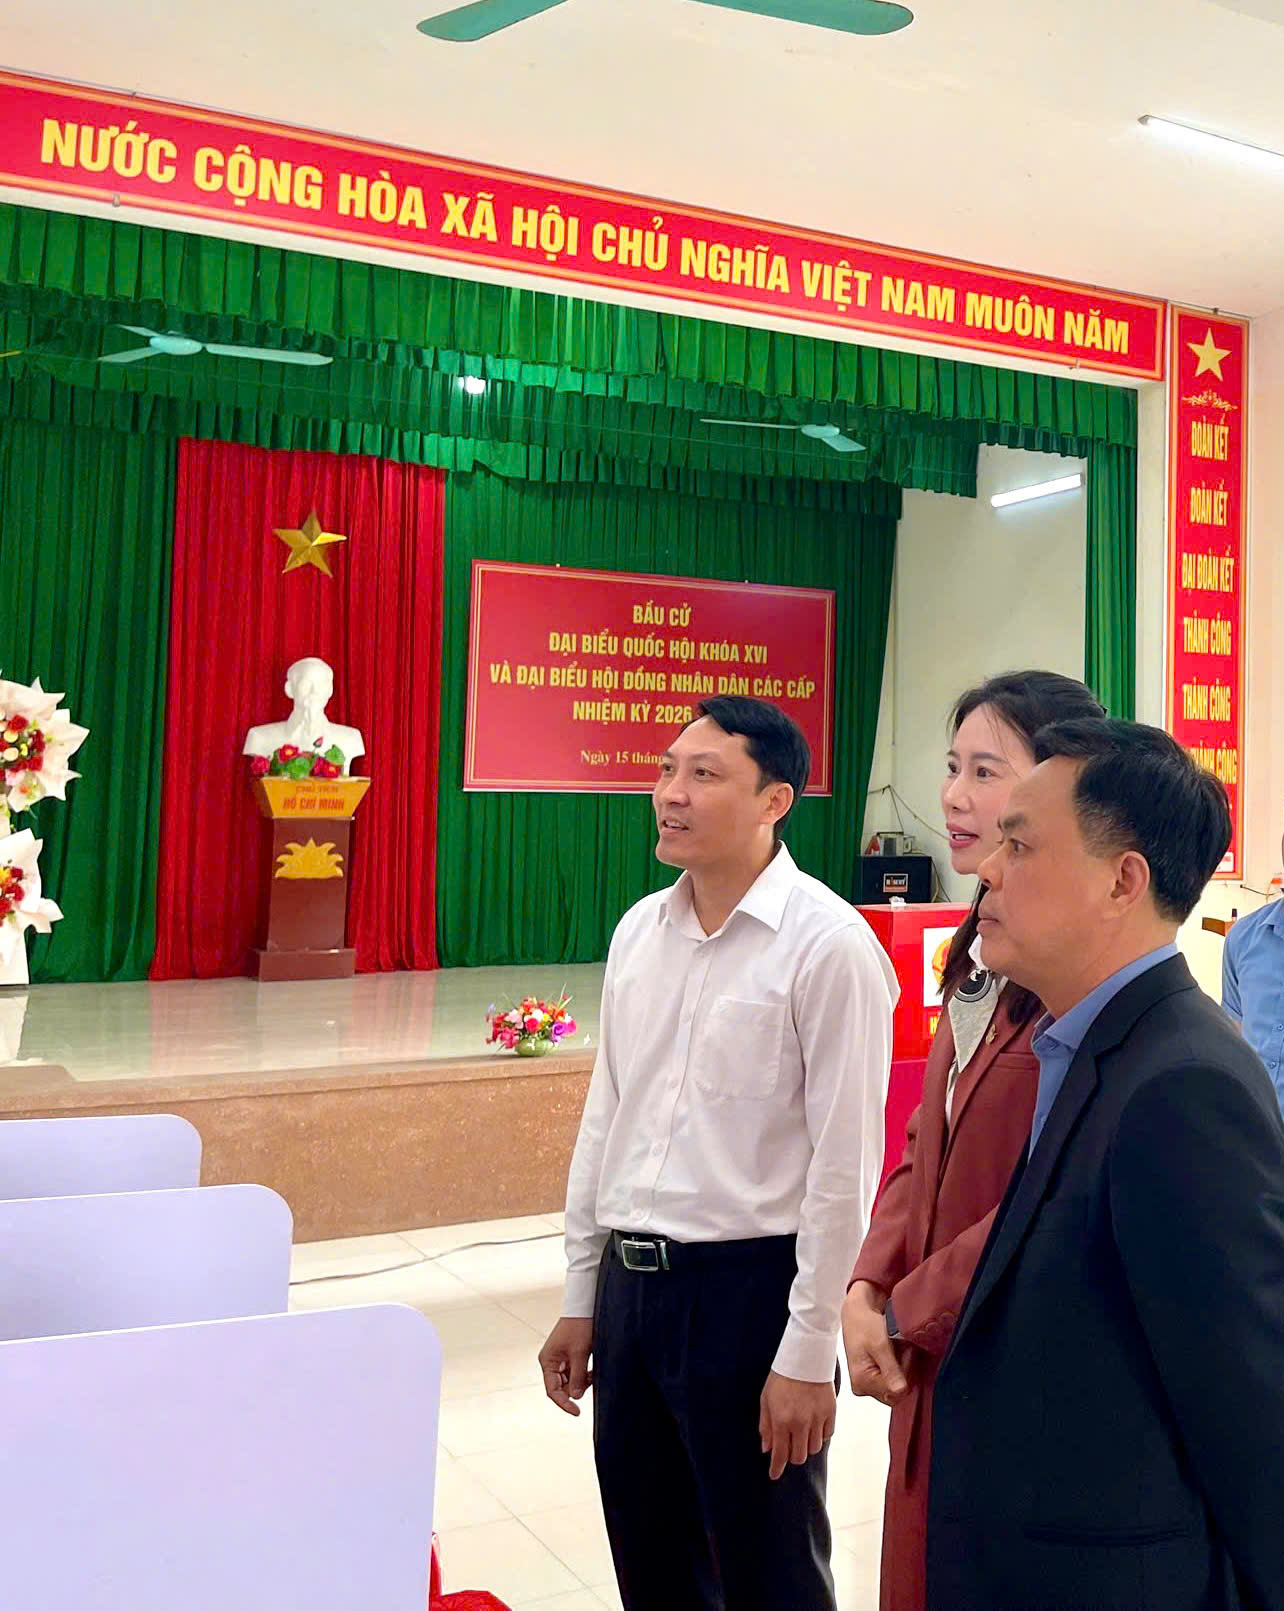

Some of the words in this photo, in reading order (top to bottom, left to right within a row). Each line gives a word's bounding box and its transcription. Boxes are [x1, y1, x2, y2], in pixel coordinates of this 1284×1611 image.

[40, 118, 177, 183] NƯỚC
[194, 145, 322, 210] CỘNG
[337, 170, 427, 230] HÒA
[441, 191, 498, 243] XÃ
[511, 204, 579, 261] HỘI
[591, 216, 668, 271] CHỦ
[680, 240, 790, 294] NGHĨA
[801, 259, 873, 312] VIỆT
[881, 276, 956, 323] NAM
[965, 295, 1055, 342] MUÔN
[1063, 308, 1130, 355] NĂM
[1213, 413, 1229, 461] KẾT
[1212, 479, 1228, 526] KẾT
[1219, 545, 1234, 593] KẾT
[669, 602, 692, 627] CỬ
[1183, 610, 1209, 655] THÀNH
[1210, 613, 1232, 656] CÔNG
[549, 632, 576, 657] ĐẠI
[582, 629, 618, 656] BIỂU
[623, 632, 665, 658] QUỐC
[669, 637, 695, 663] HỘI
[700, 640, 739, 662] KHÓA
[744, 645, 768, 664] XVI
[490, 660, 512, 684] VÀ
[517, 667, 545, 691] ĐẠI
[550, 661, 587, 688] BIỂU
[592, 668, 619, 694] HỘI
[671, 671, 713, 694] NHÂN
[718, 673, 749, 696] DÂN
[753, 675, 782, 697] CÁC
[787, 672, 815, 699] CẤP
[1183, 677, 1209, 721] THÀNH
[1209, 678, 1231, 722] CÔNG
[573, 698, 625, 725] NHIỆM
[630, 699, 650, 723] KỲ
[655, 703, 692, 724] 2026
[580, 750, 609, 766] Ngày
[616, 751, 629, 763] 15
